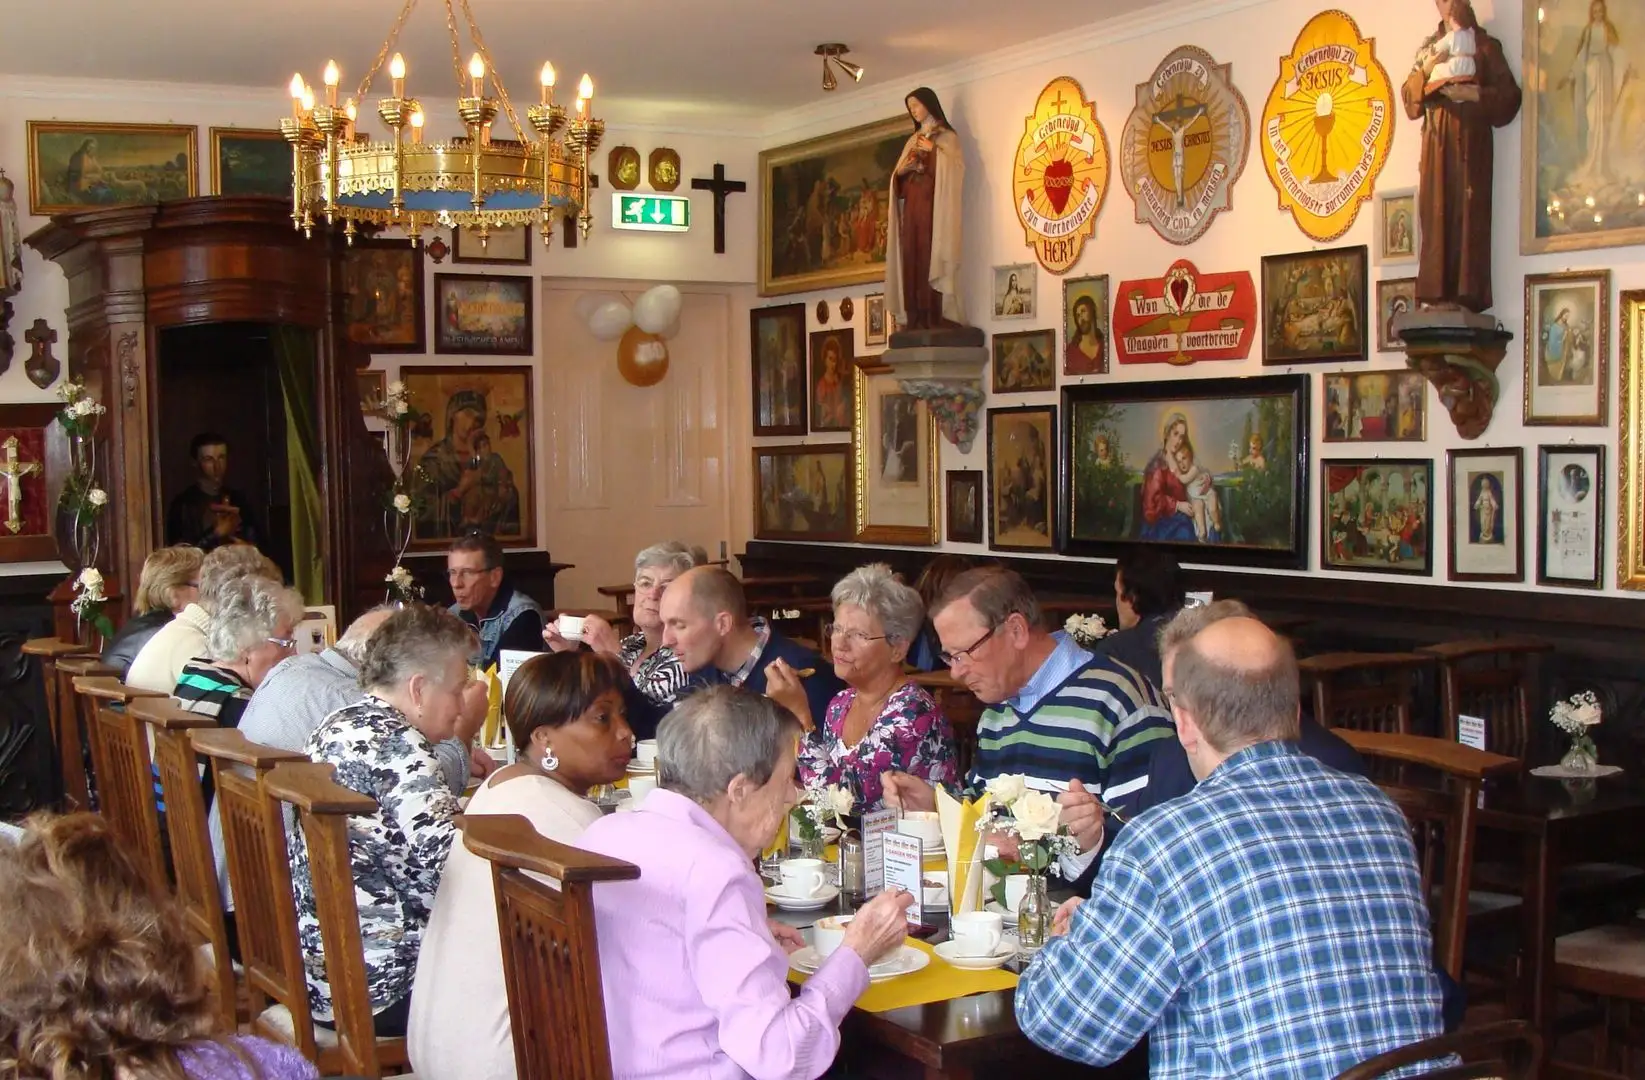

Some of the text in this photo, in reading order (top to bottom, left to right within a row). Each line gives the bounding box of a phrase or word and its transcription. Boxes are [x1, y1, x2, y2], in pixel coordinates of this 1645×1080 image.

[1305, 68, 1342, 91] JESUS
[1151, 131, 1211, 153] JESUS CHRISTUS
[1325, 170, 1363, 214] sacrament
[1363, 105, 1383, 145] altaars
[1202, 169, 1220, 207] mensch
[1043, 237, 1074, 263] HERT
[1198, 295, 1211, 308] die
[1217, 291, 1227, 306] de
[1128, 332, 1238, 352] Maagden voortbrengt
